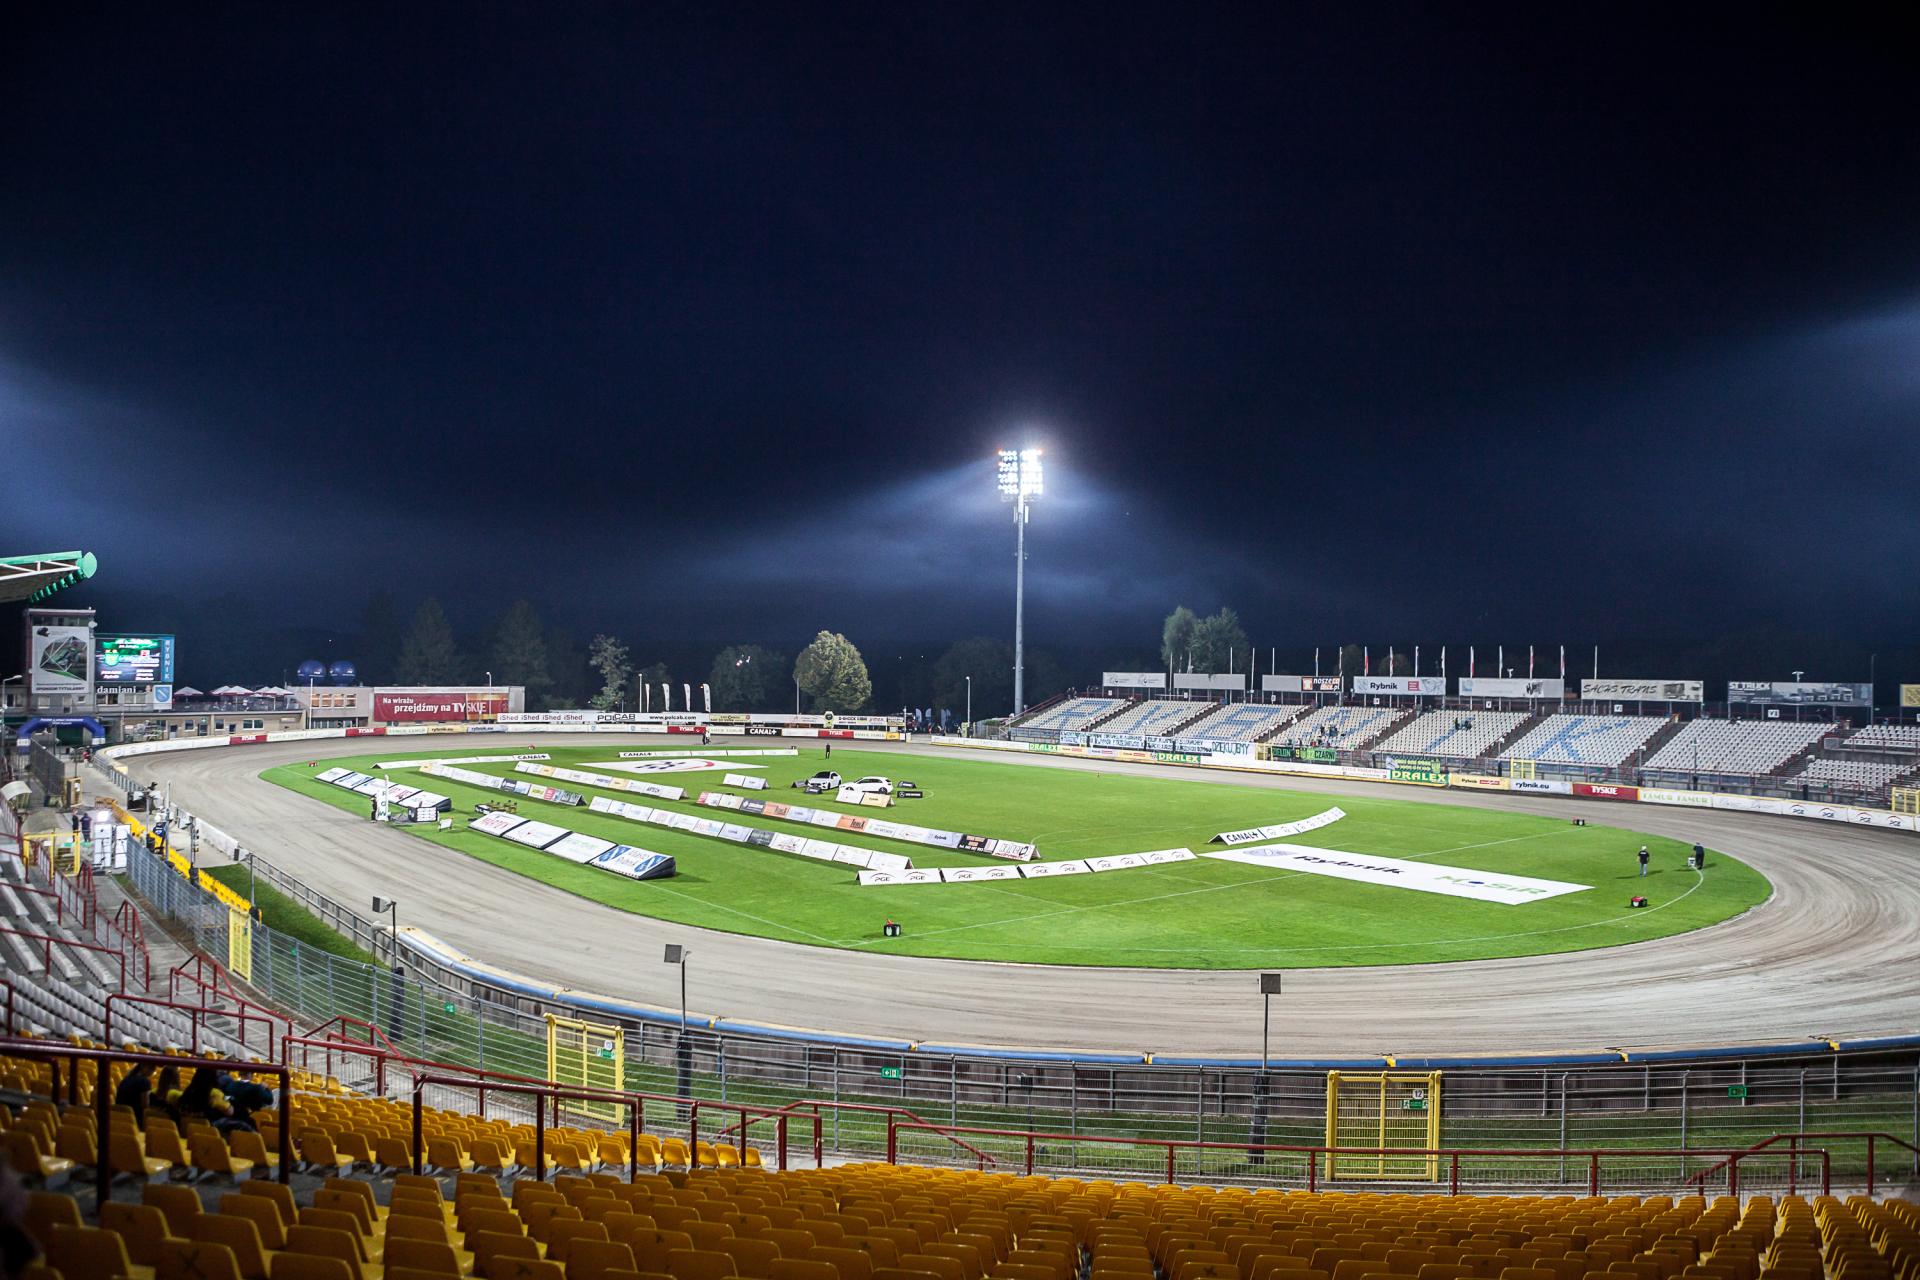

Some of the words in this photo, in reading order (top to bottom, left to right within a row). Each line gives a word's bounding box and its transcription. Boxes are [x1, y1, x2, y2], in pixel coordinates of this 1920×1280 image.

[97, 686, 137, 694] damiani
[1370, 682, 1398, 690] Rybnik
[1620, 685, 1657, 695] TRANS
[394, 702, 440, 714] przejdźmy
[441, 704, 451, 712] na
[1158, 752, 1198, 763] DRALEX
[1391, 770, 1446, 782] DRALEX
[1515, 781, 1550, 790] rybnik.eu
[1590, 785, 1618, 795] TYSKIE
[1226, 831, 1259, 843] CANAL+
[1294, 855, 1407, 874] Rybnik
